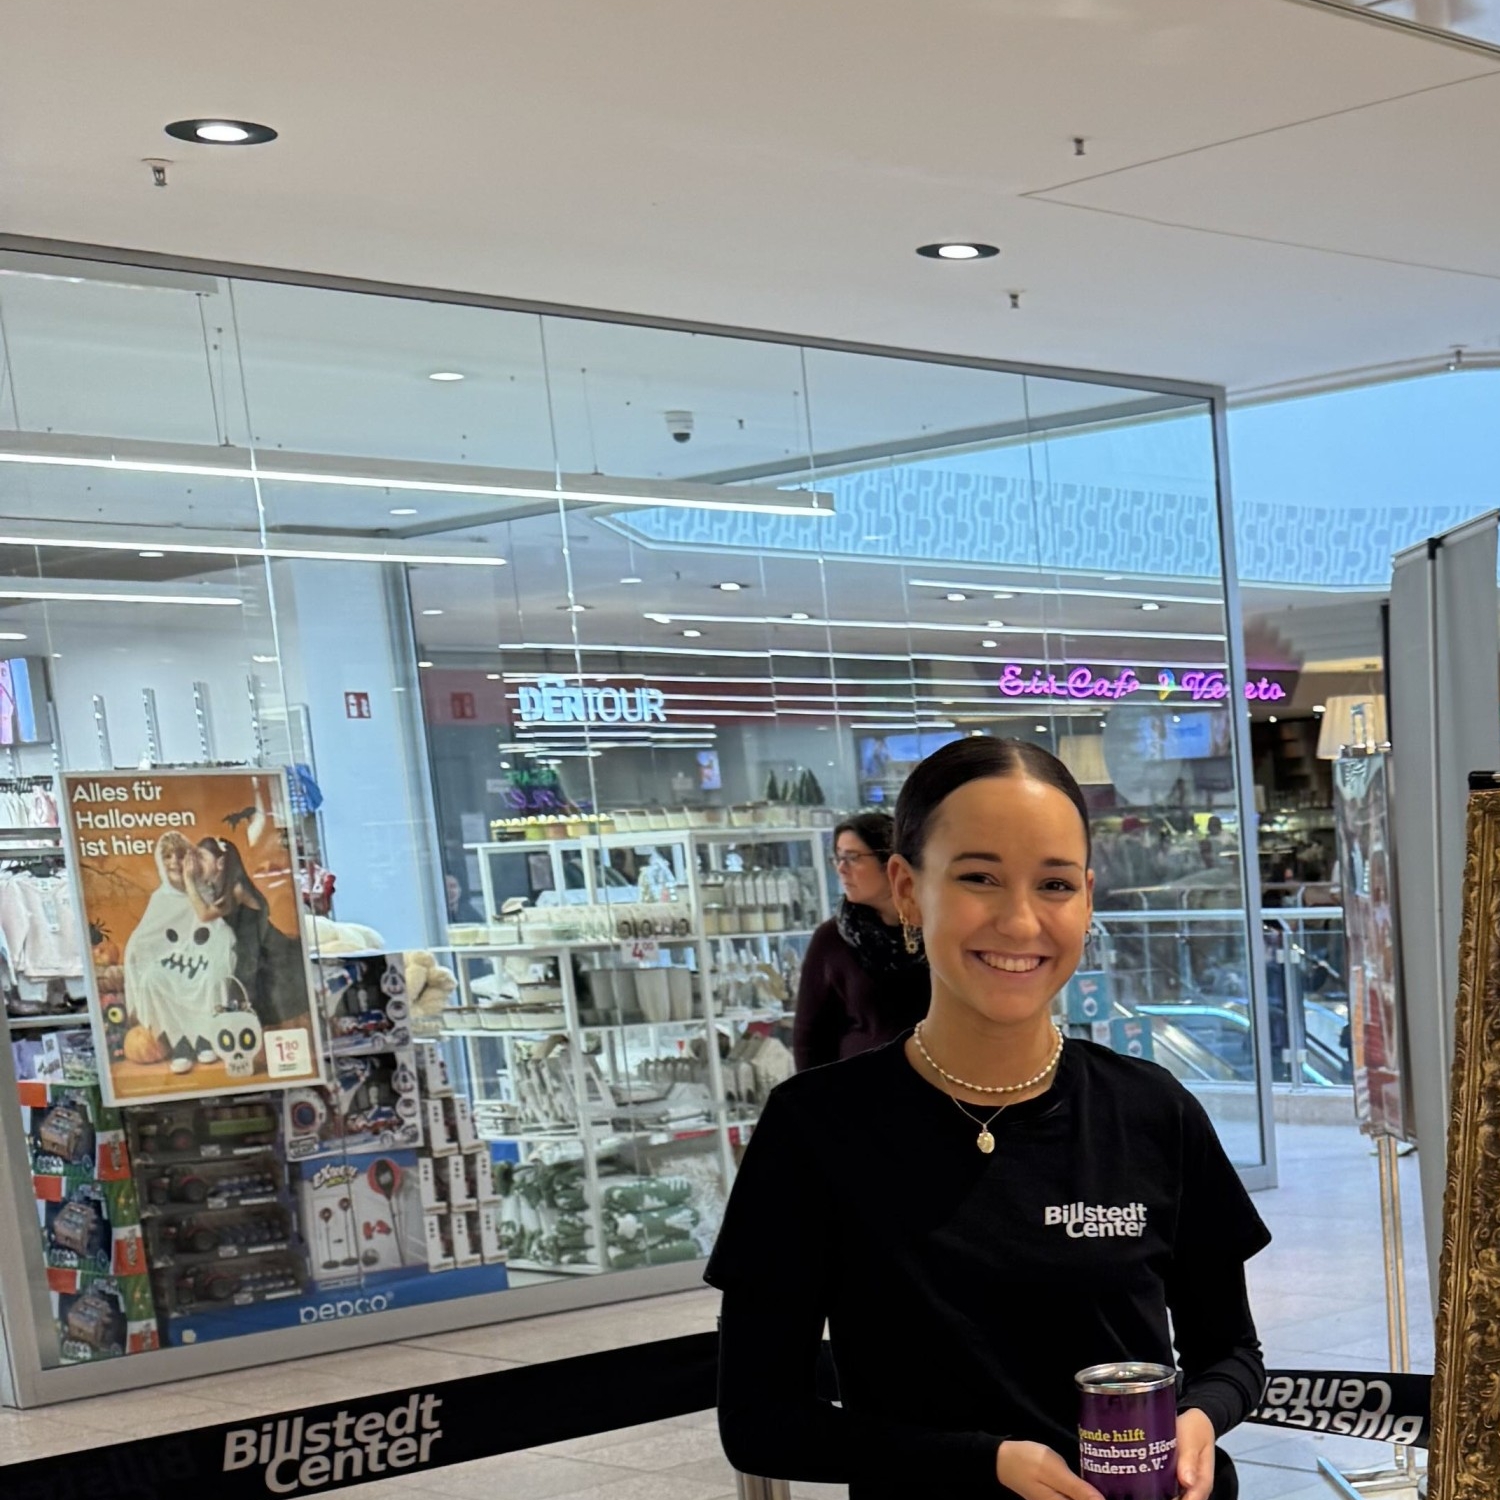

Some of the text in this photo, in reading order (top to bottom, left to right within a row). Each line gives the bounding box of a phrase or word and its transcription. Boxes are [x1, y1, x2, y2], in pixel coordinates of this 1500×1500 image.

[1181, 671, 1286, 700] Veeto
[73, 780, 163, 803] Alles für
[76, 808, 195, 829] Halloween
[79, 834, 154, 857] ist hier
[1044, 1201, 1148, 1226] Billstedt
[1065, 1217, 1147, 1238] Center
[221, 1393, 443, 1472] Billstedt
[1112, 1429, 1145, 1442] hilft
[265, 1429, 443, 1493] Center
[1083, 1442, 1148, 1460] Hamburg
[1083, 1457, 1137, 1475] Kindern
